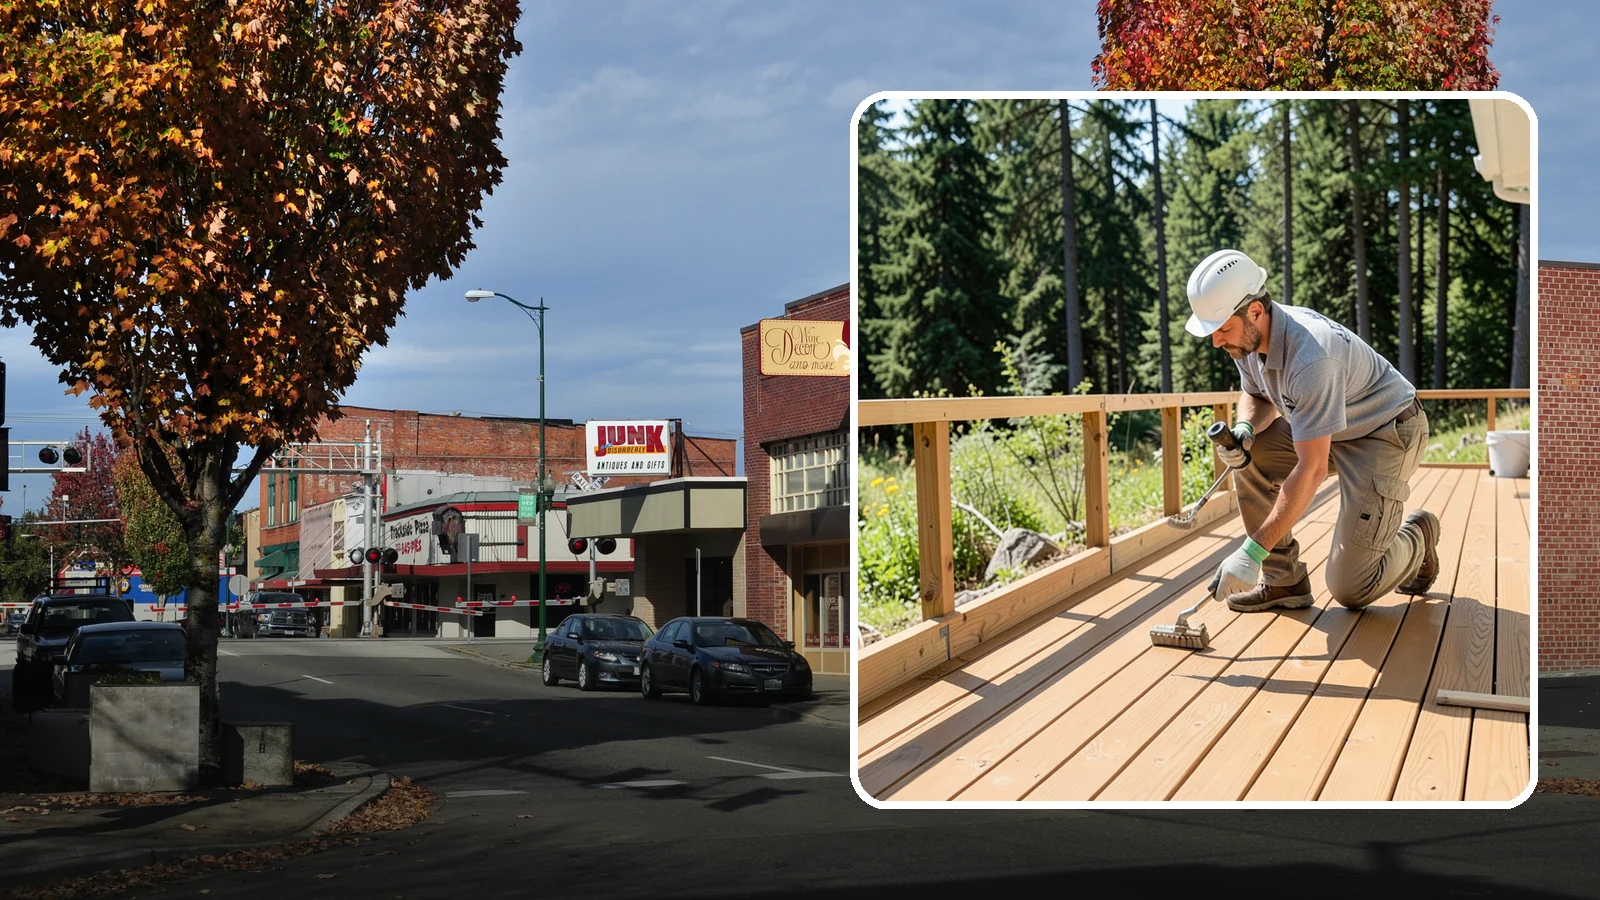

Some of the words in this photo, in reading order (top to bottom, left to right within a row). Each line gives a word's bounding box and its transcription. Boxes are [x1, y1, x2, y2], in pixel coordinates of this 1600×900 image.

[764, 327, 830, 365] Decor
[596, 425, 665, 457] JUNK
[607, 445, 646, 454] DISORDERLY
[597, 461, 628, 470] ANTIQUES
[631, 460, 644, 470] AND
[646, 460, 666, 470] GIFTS
[390, 523, 412, 539] Trackside
[414, 519, 429, 535] Pizza
